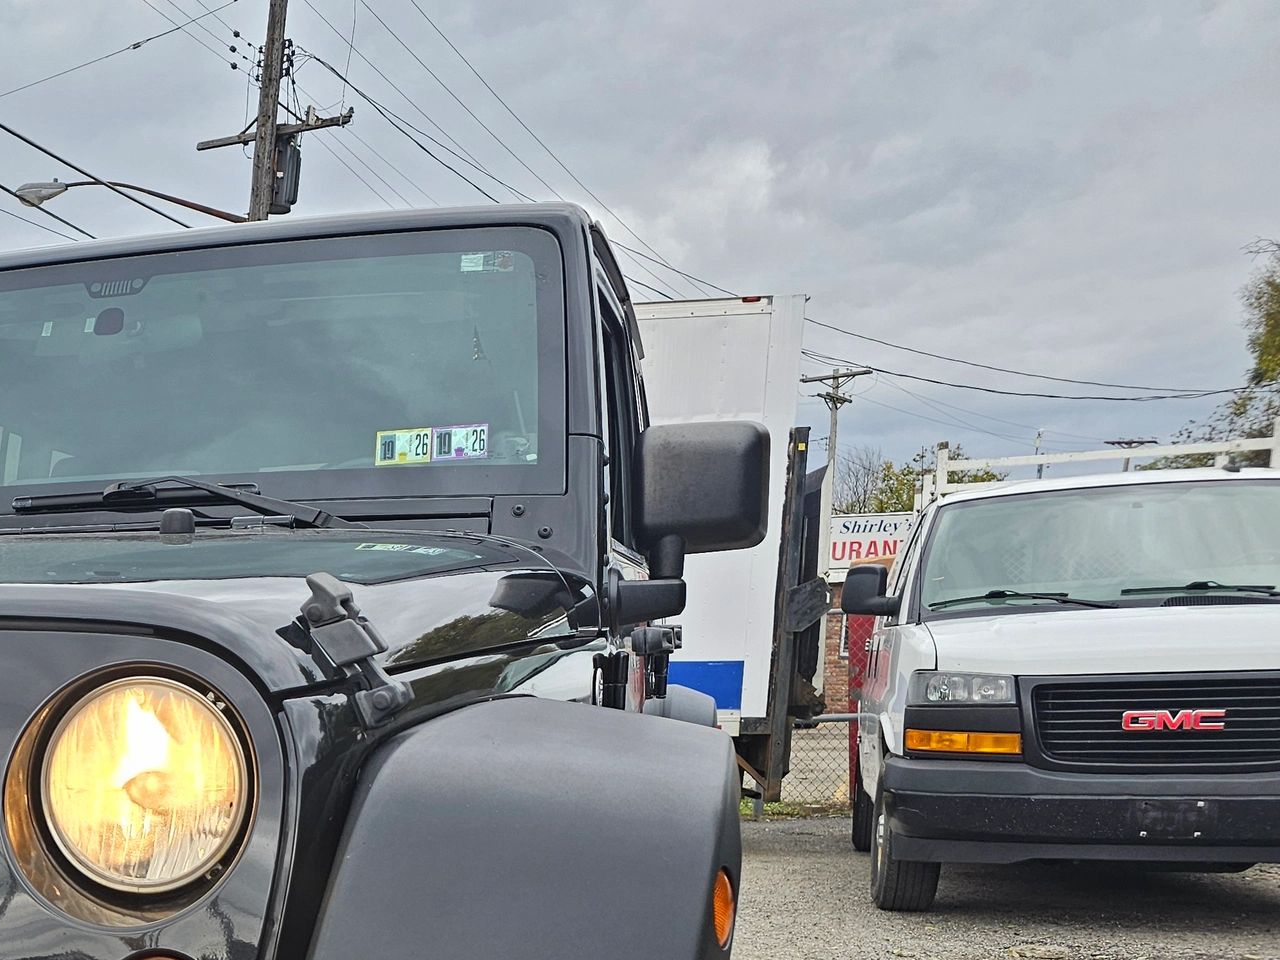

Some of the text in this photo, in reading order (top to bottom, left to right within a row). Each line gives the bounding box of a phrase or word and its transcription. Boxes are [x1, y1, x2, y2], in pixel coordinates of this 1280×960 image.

[415, 433, 429, 456] 26
[472, 429, 485, 452] 26
[831, 539, 904, 561] URAN
[1122, 709, 1226, 731] GMC
